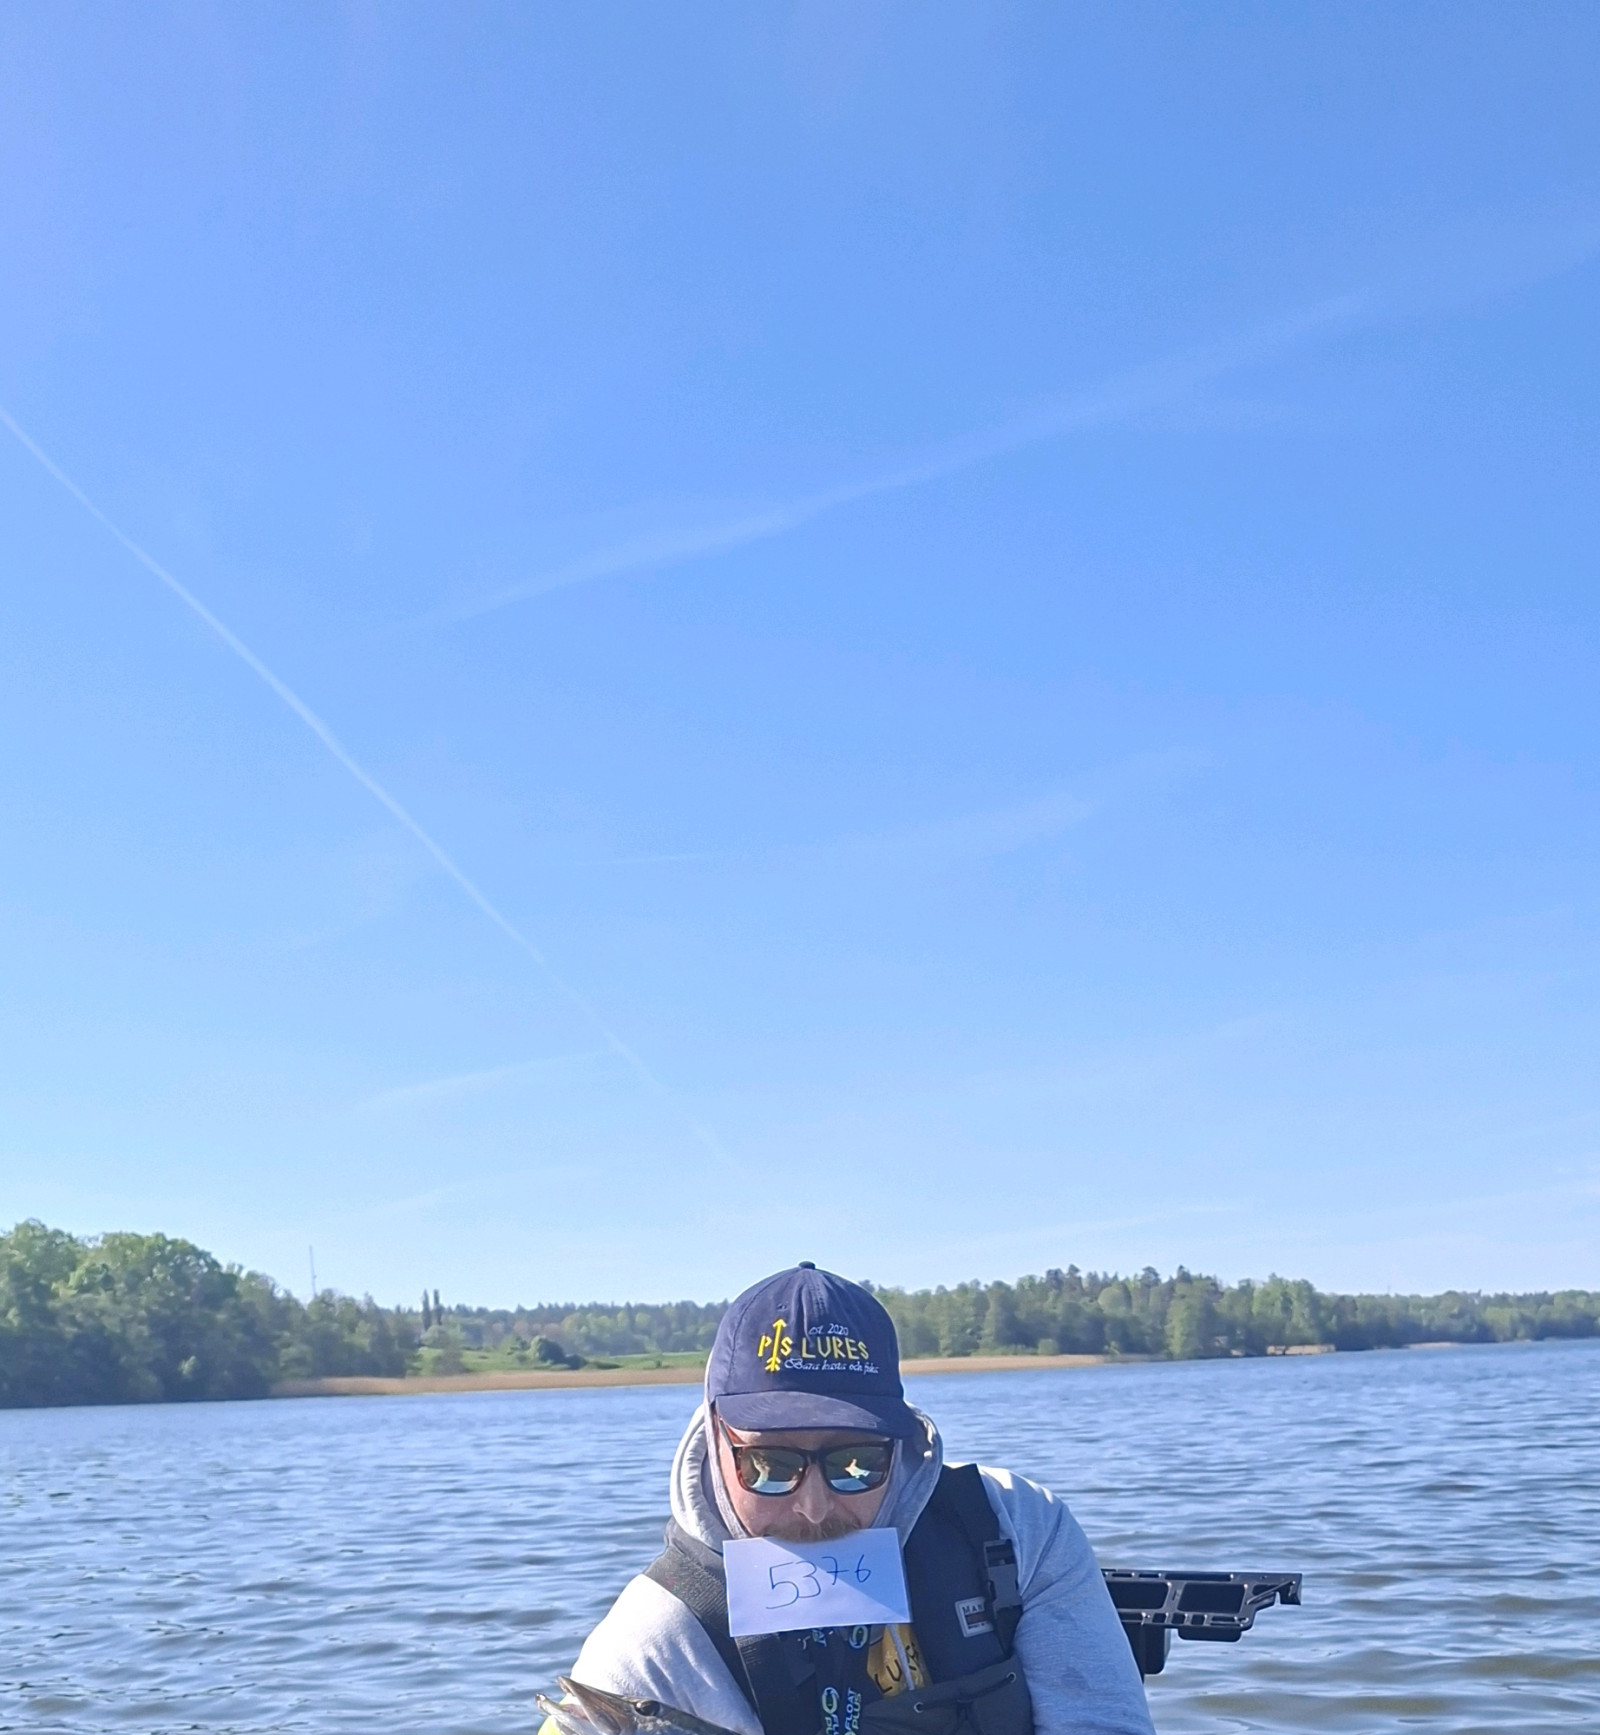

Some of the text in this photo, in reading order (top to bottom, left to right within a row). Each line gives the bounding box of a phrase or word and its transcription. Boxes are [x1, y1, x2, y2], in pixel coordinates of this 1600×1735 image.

[801, 1336, 869, 1360] LURES
[827, 1323, 849, 1336] 2020
[766, 1554, 871, 1610] 5376
[845, 1687, 856, 1731] FLOAT
[852, 1693, 862, 1730] PLUS
